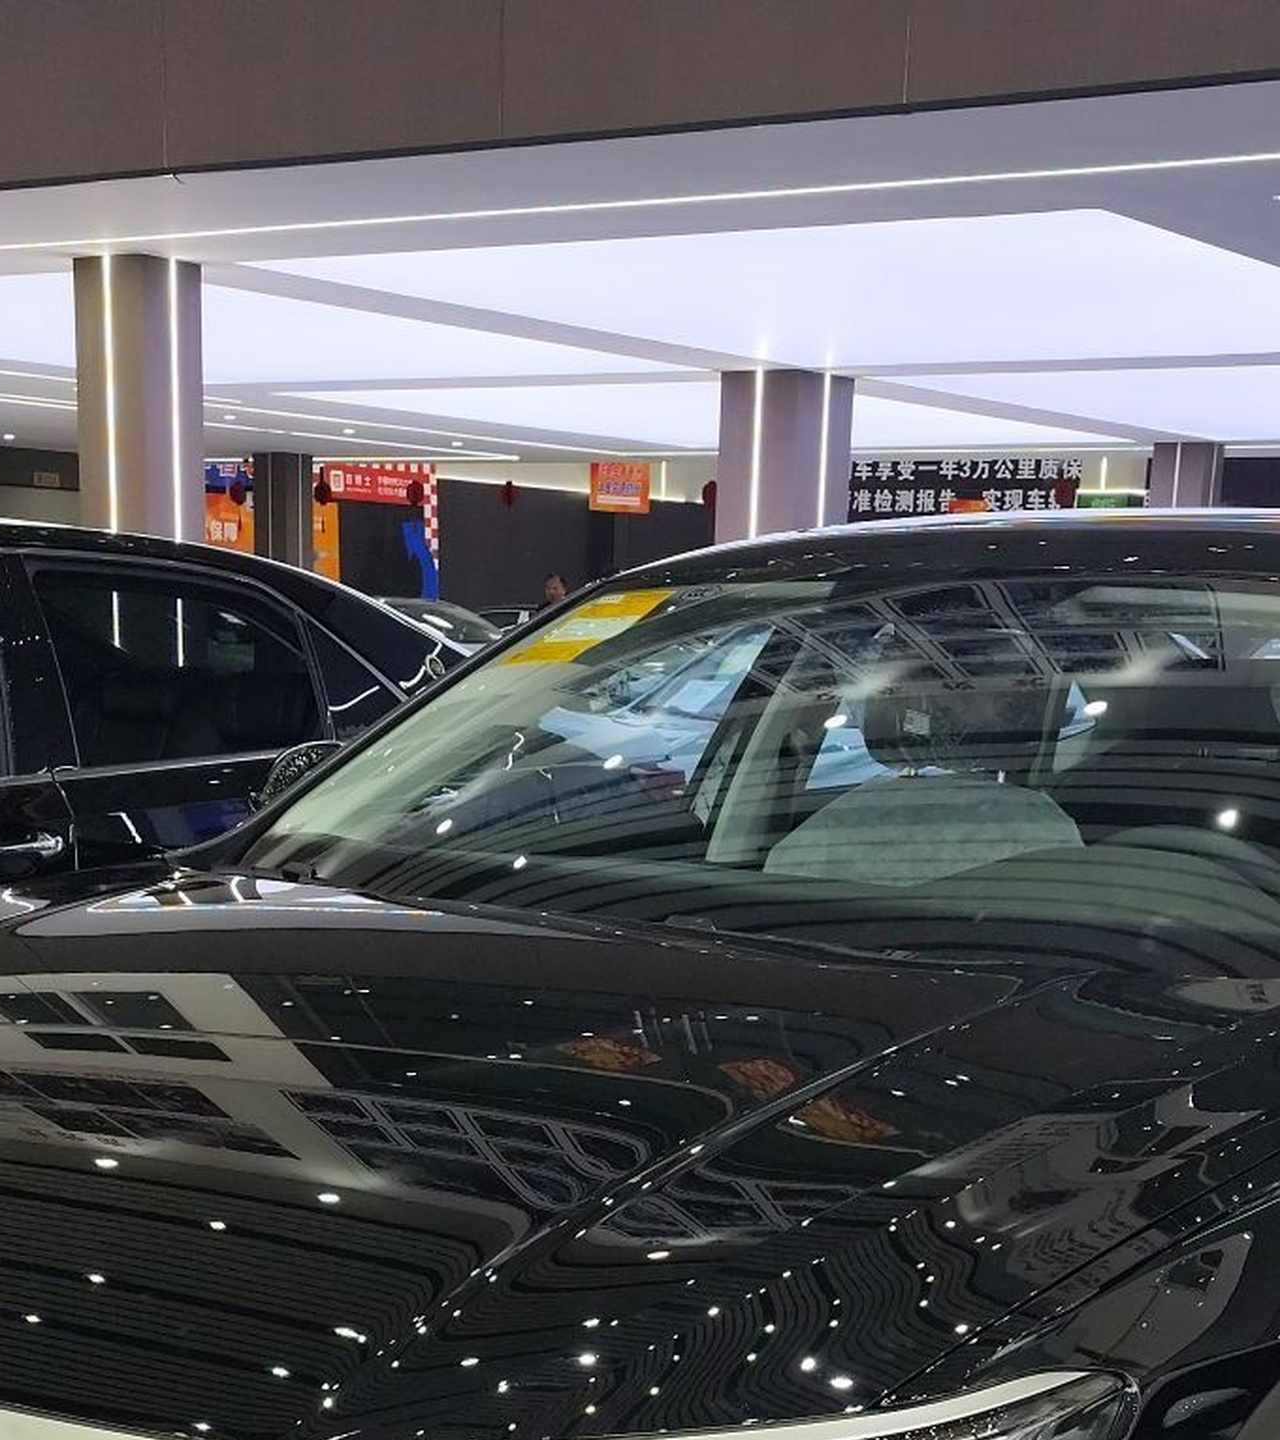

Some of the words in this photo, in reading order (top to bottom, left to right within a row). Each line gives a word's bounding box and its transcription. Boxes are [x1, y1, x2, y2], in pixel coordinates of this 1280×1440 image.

[854, 459, 1083, 481] 车享受一年3万公里质保
